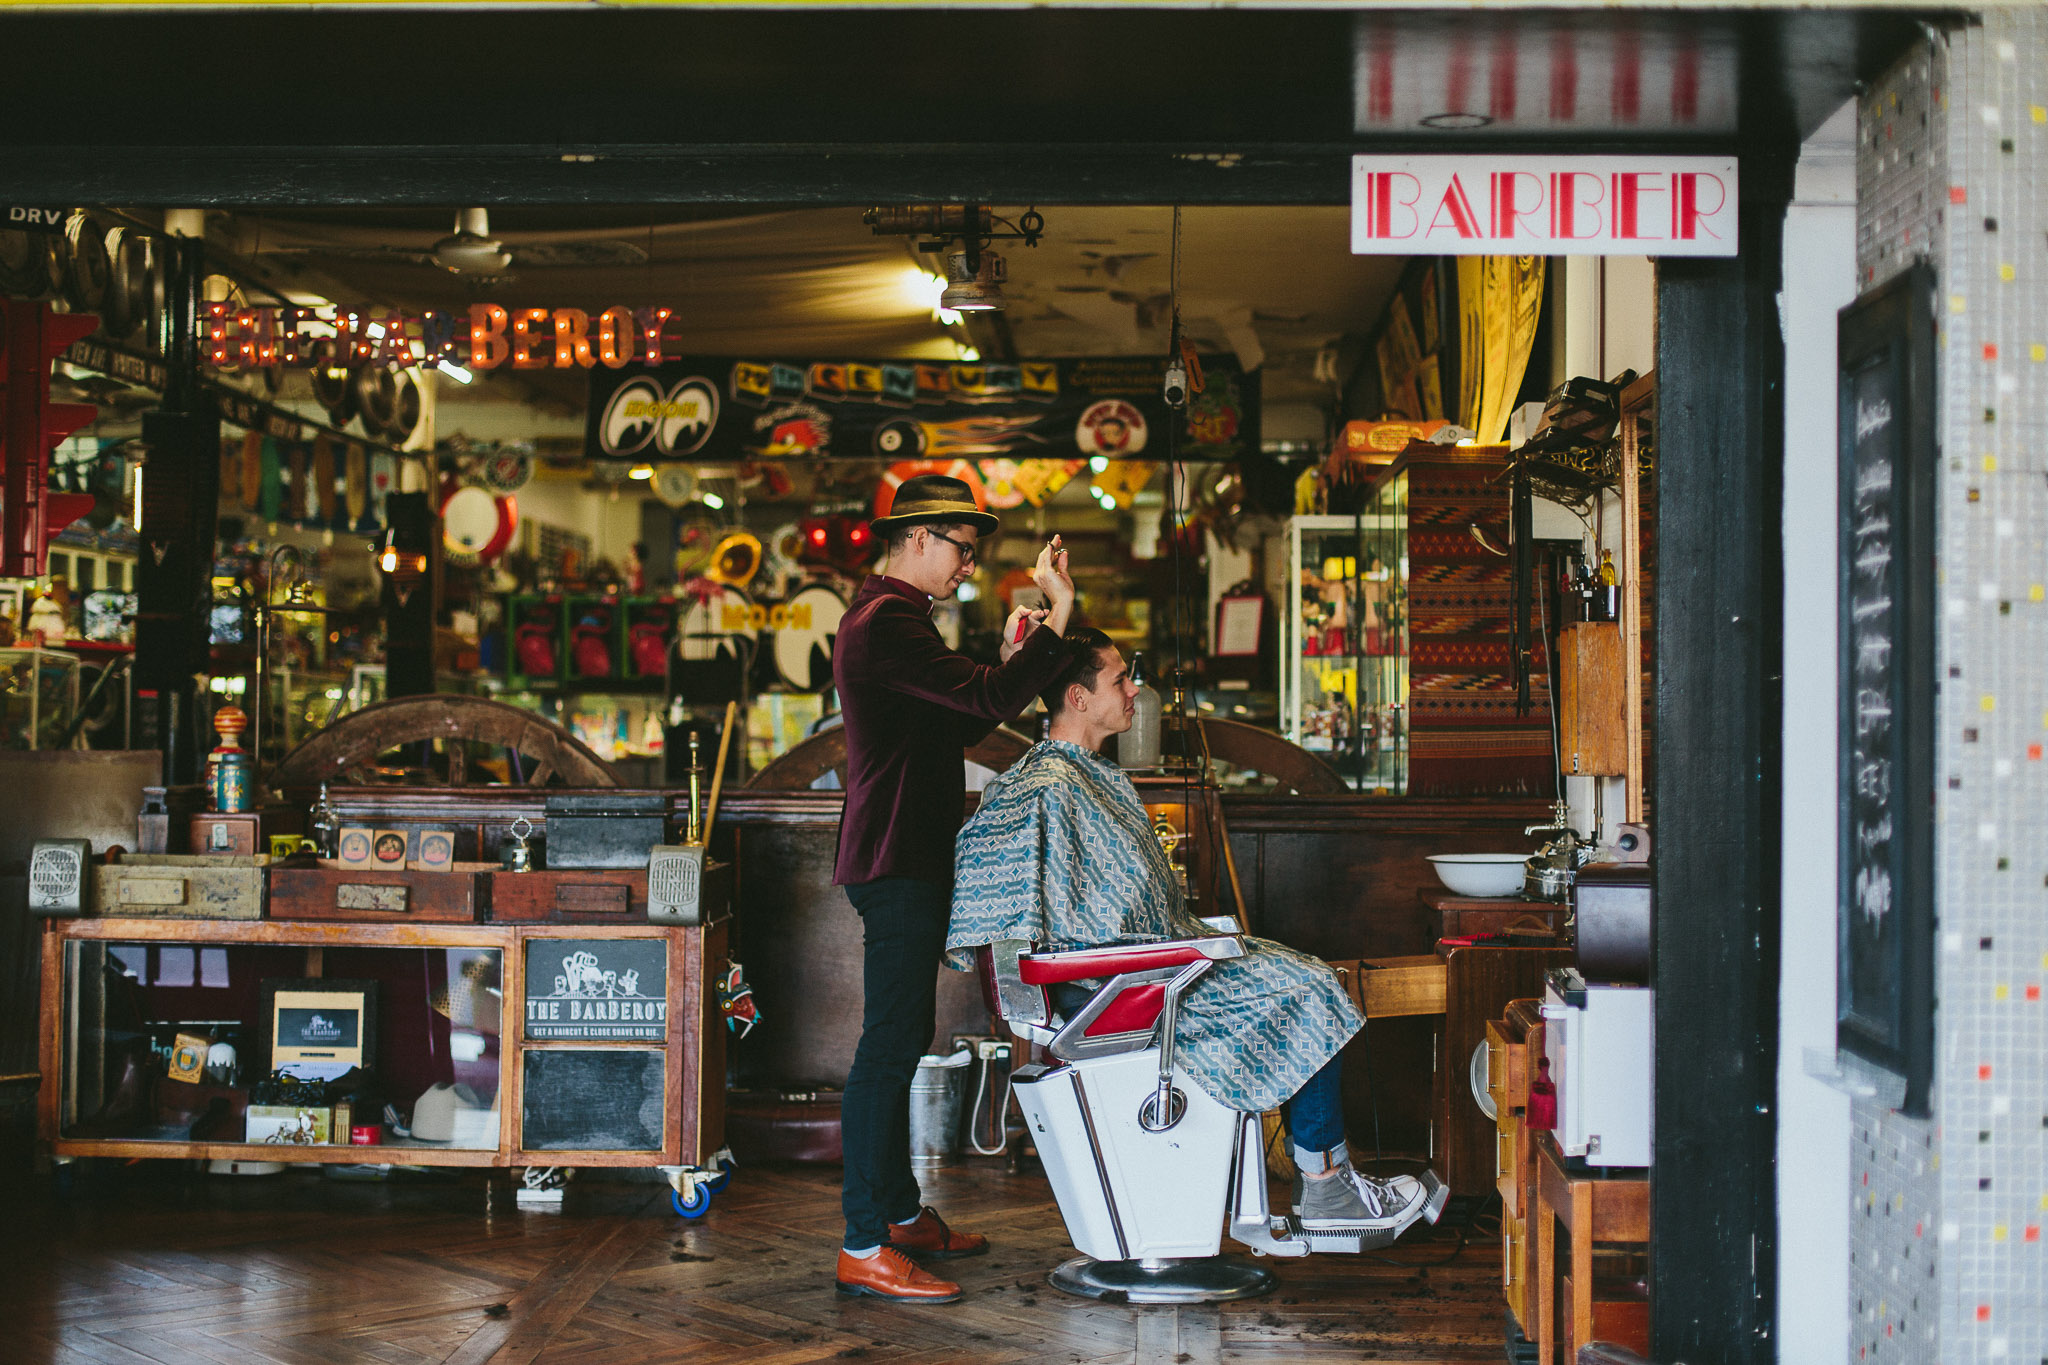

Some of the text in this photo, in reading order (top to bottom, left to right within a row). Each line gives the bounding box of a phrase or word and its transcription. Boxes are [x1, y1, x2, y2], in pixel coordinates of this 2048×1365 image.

[9, 207, 62, 226] DRV
[1367, 171, 1726, 240] BARBER
[201, 302, 673, 371] THE BARBEROY
[812, 363, 1058, 397] CENTURY
[624, 401, 699, 418] MOON
[720, 603, 813, 631] MOON
[526, 999, 666, 1021] THE BARBEROY
[554, 1026, 582, 1036] HAIRCUT
[590, 1026, 611, 1036] CLOSE
